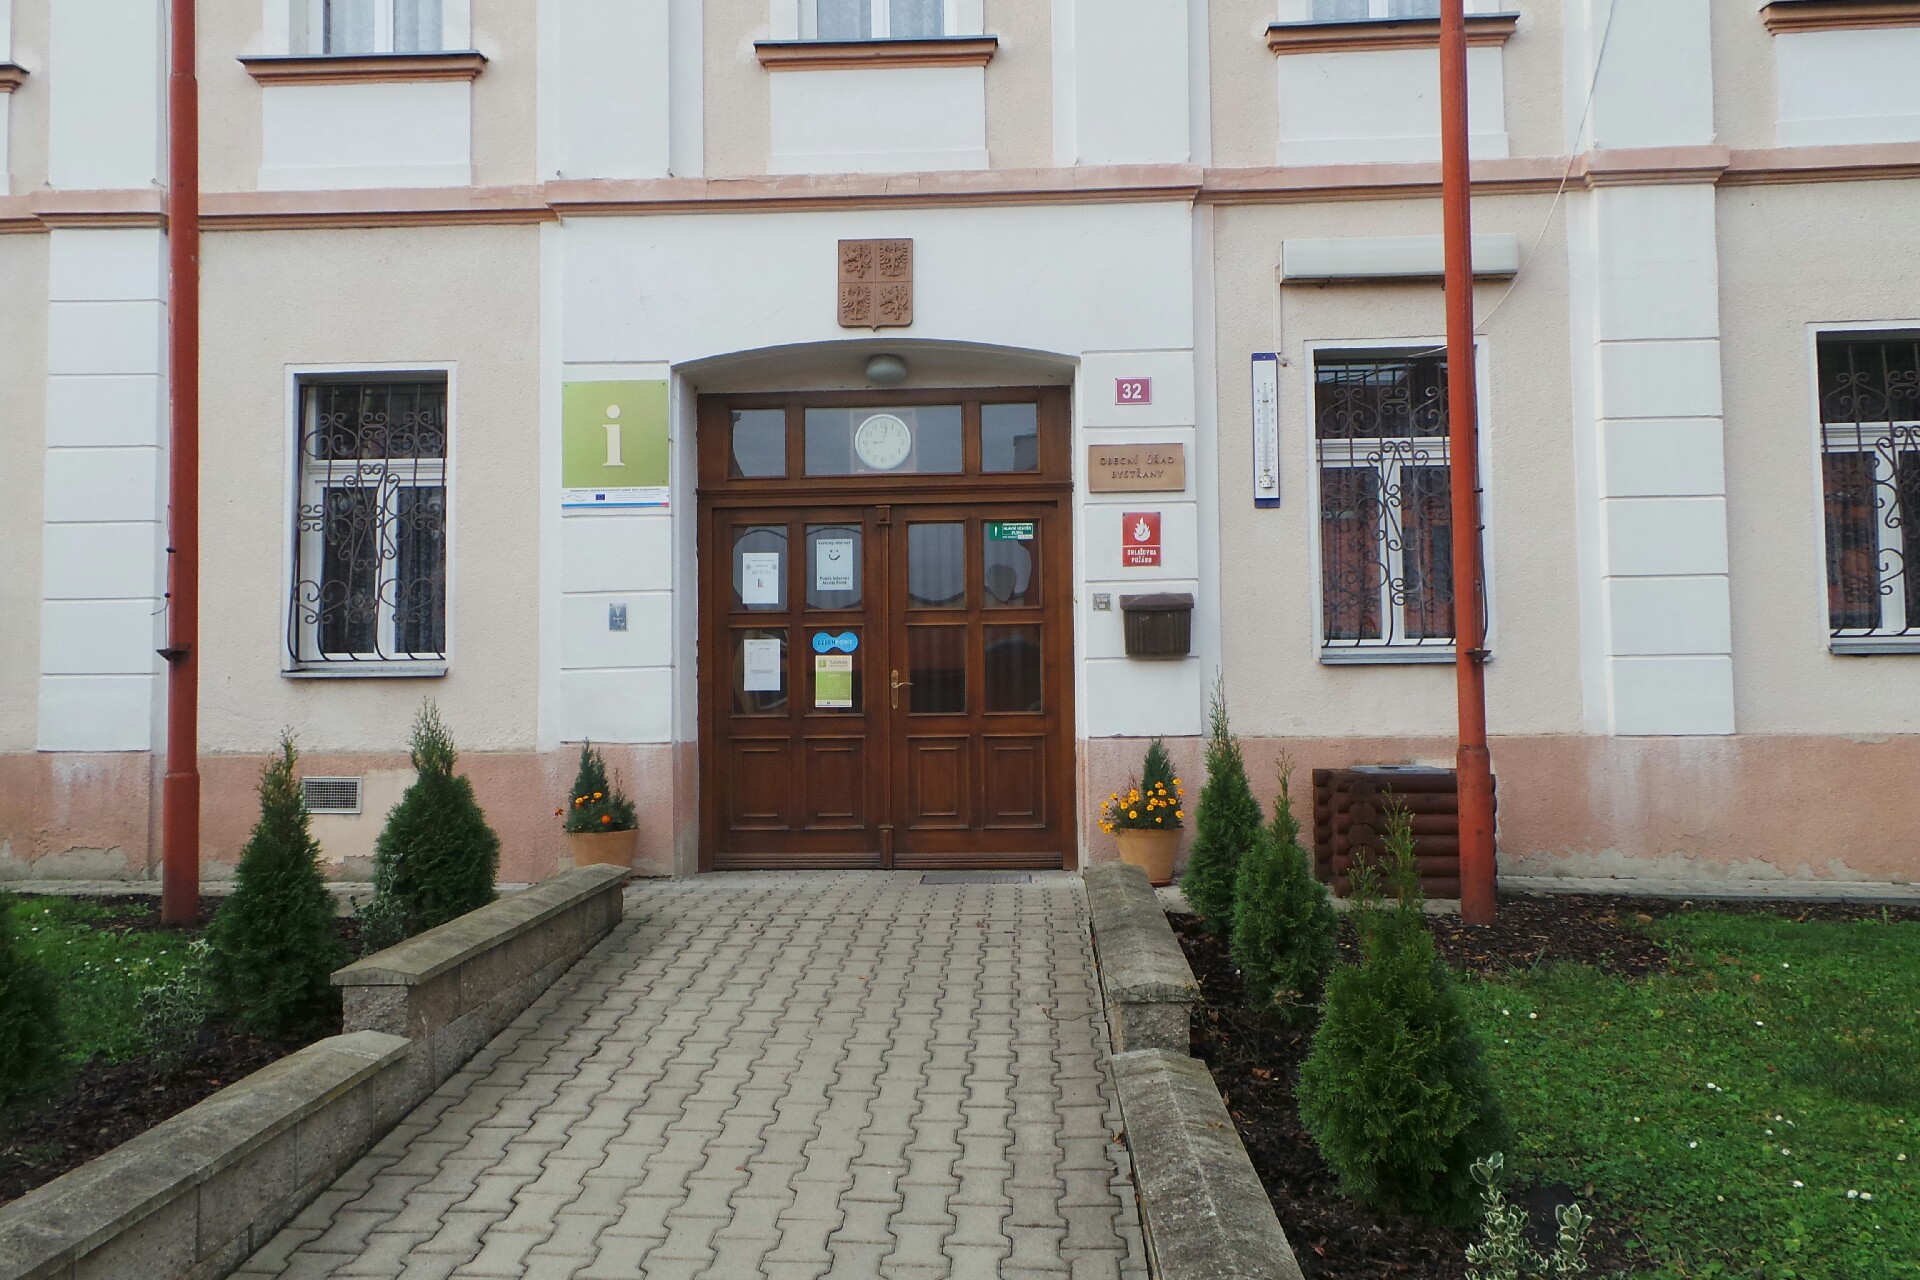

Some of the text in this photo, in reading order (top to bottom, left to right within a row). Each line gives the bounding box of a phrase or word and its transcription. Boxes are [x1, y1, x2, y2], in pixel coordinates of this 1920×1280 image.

[1122, 383, 1142, 399] 32
[602, 404, 626, 466] i
[1099, 454, 1138, 465] OBECNÍ
[1111, 467, 1164, 479] BYSTŘANY
